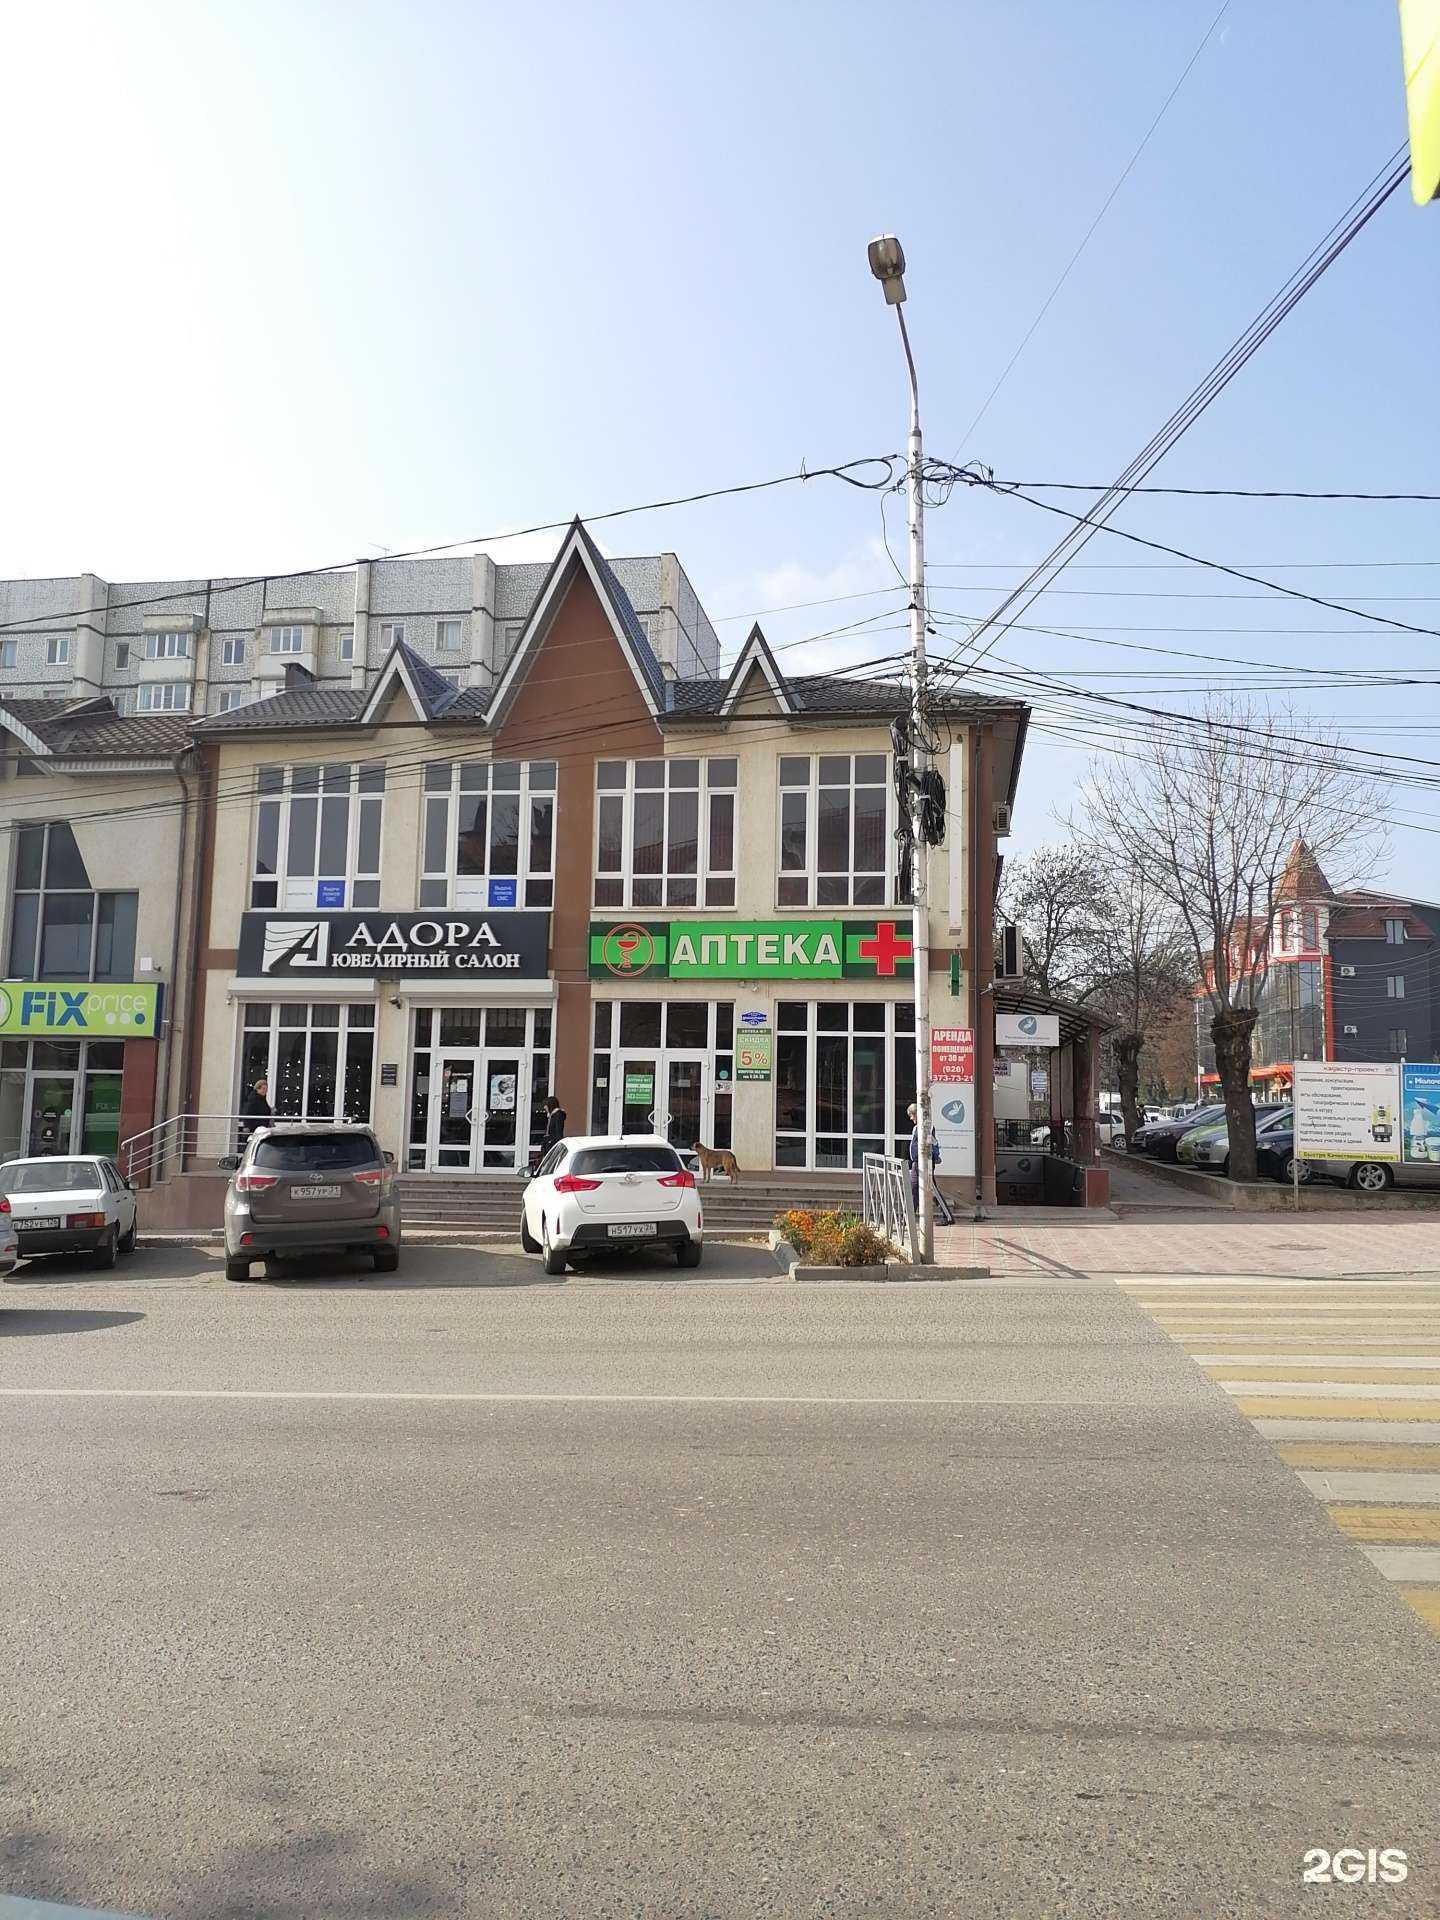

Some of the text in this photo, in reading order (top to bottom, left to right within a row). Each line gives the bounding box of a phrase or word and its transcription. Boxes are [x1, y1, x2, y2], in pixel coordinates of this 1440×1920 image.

[345, 921, 501, 952] АДОРА
[331, 950, 521, 969] ЮВЕЛИРНЫЙ САЛОН
[670, 934, 841, 966] АПТЕКА
[88, 993, 148, 1014] price
[933, 1030, 972, 1043] АРЕНДА
[932, 1045, 973, 1053] ПОМЕЩЕНИЙ
